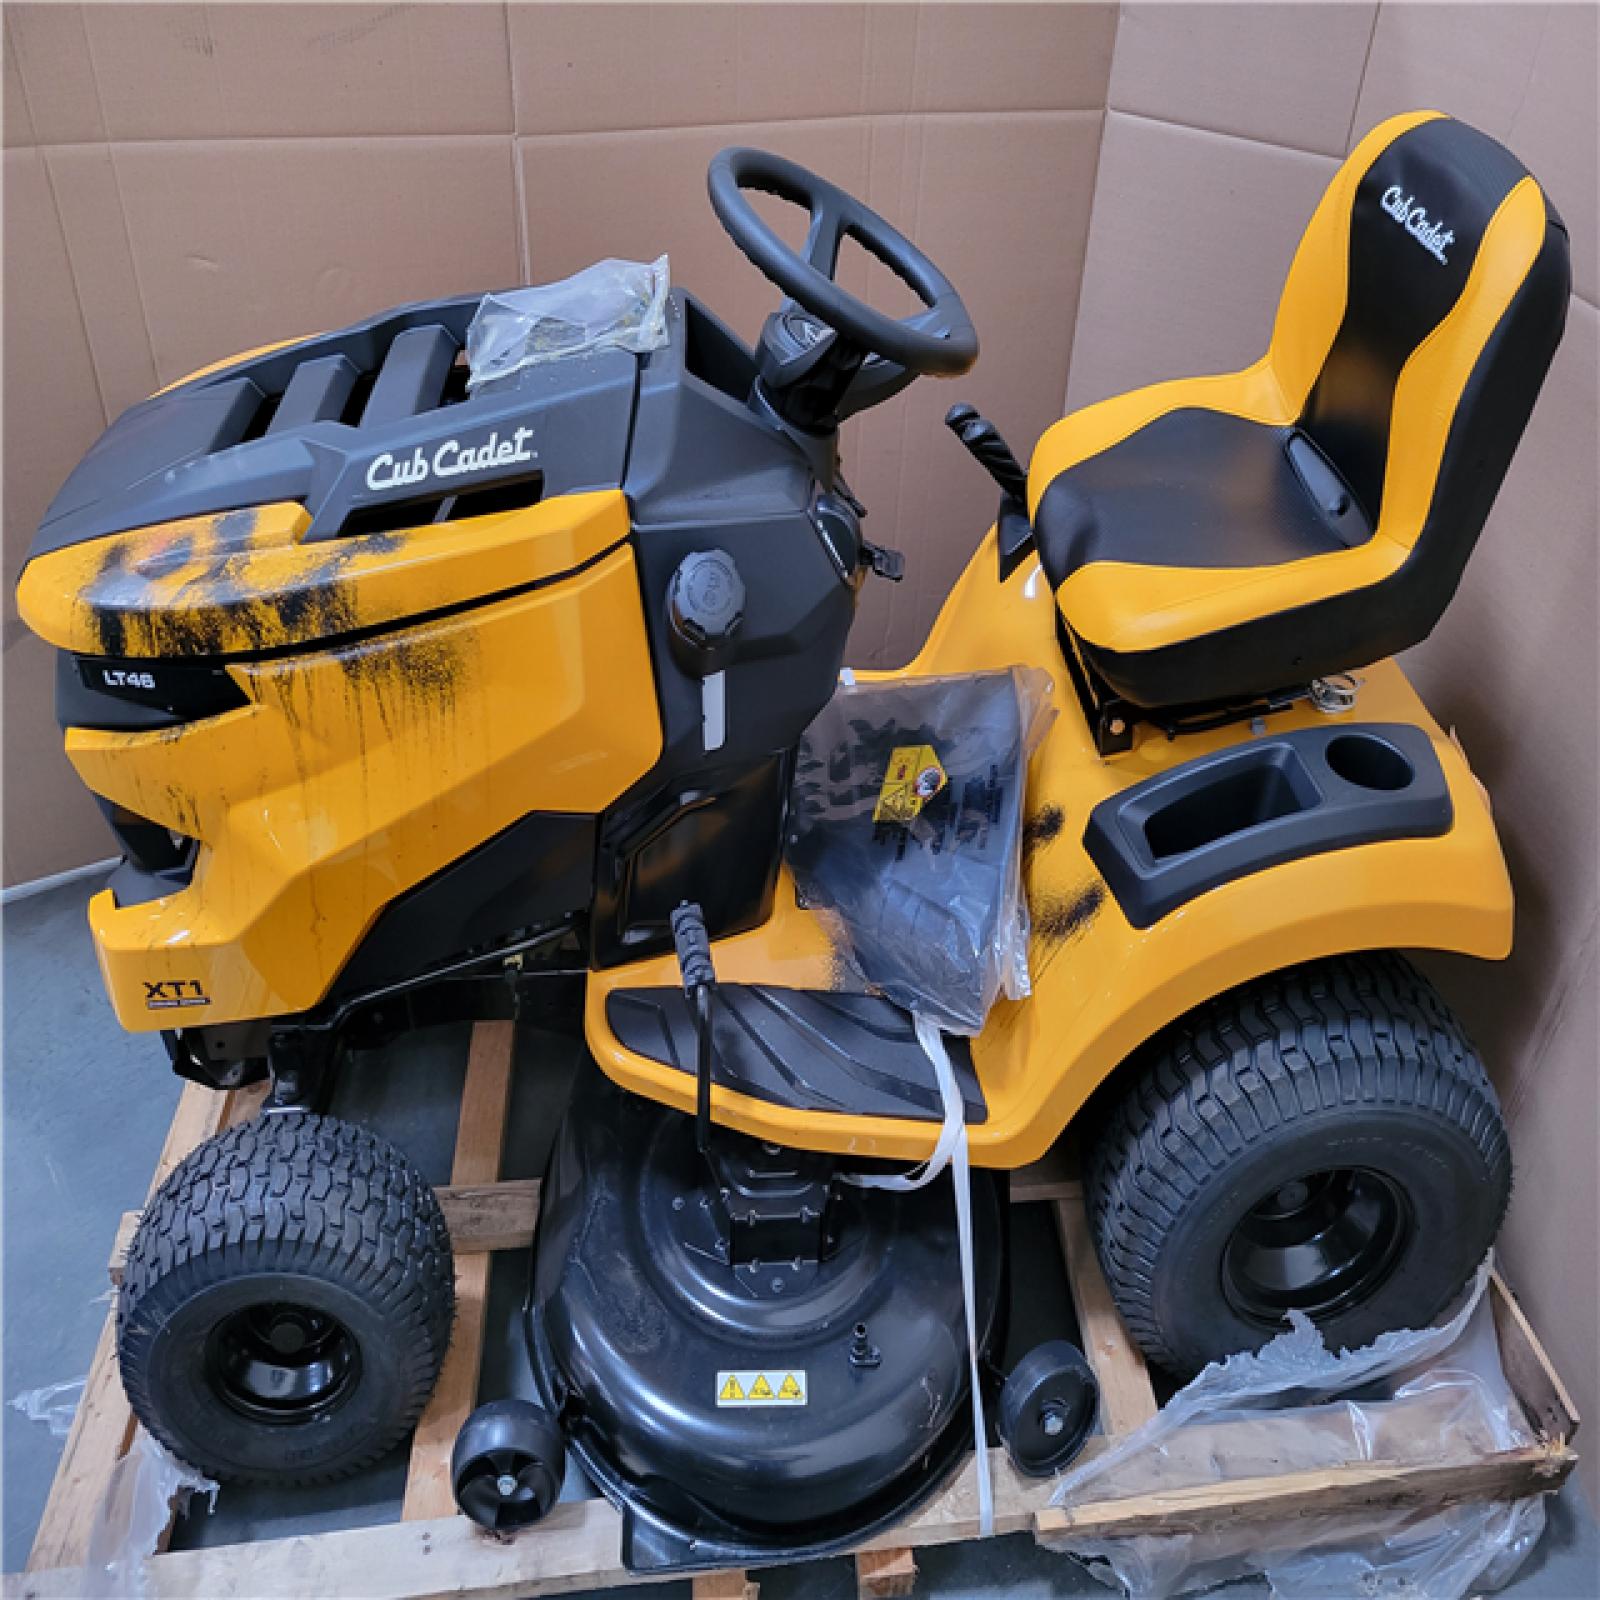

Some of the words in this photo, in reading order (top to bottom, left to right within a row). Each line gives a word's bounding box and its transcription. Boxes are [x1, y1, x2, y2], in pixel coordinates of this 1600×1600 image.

[1380, 185, 1415, 223] Cub
[1405, 207, 1455, 261] Cadet
[367, 452, 428, 490] Cub
[433, 426, 534, 477] Cadet
[142, 980, 203, 998] XT1
